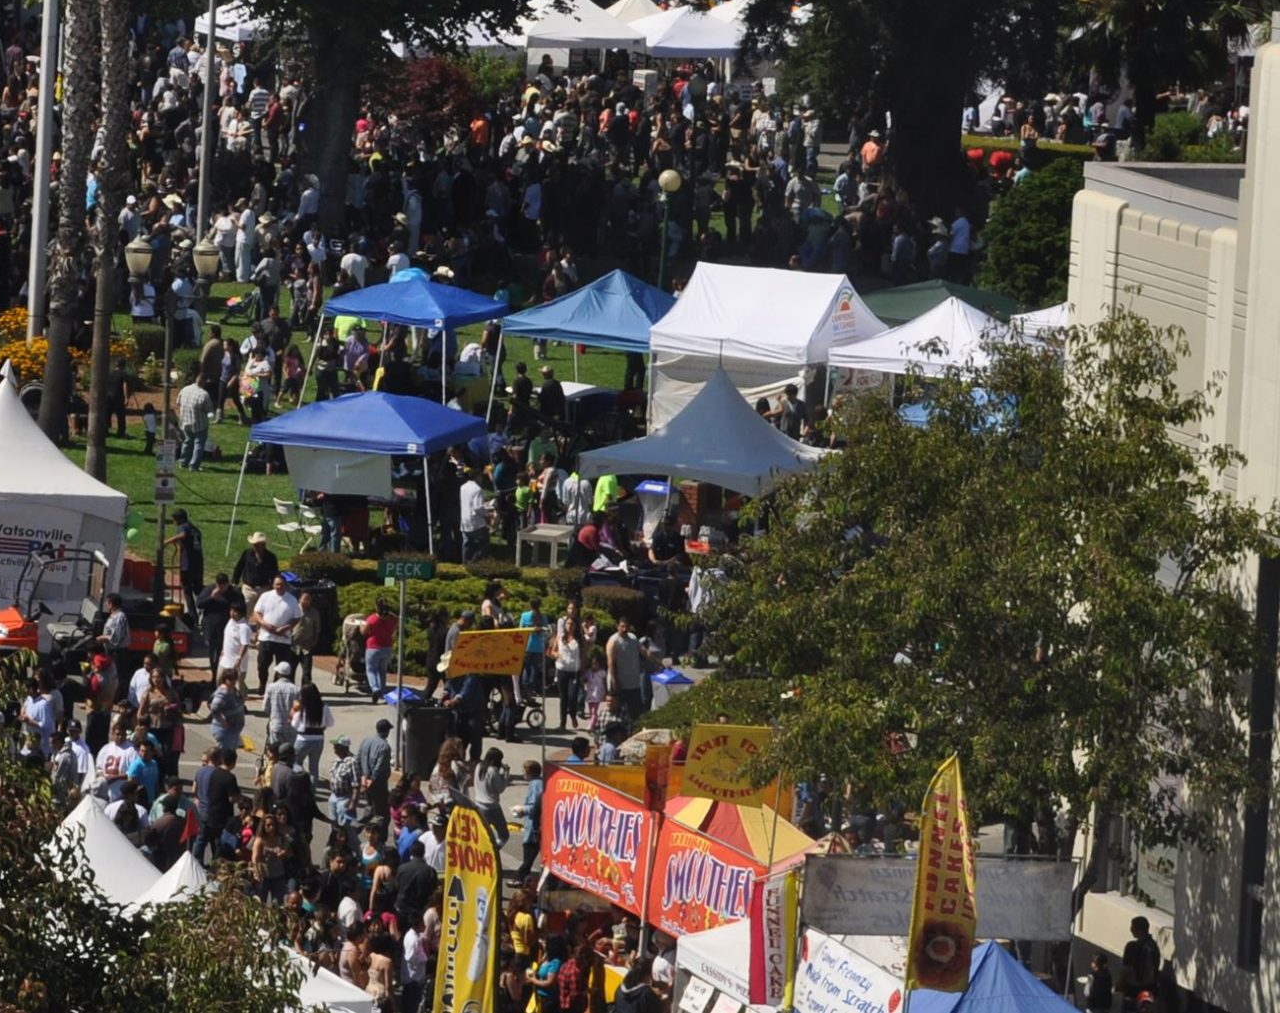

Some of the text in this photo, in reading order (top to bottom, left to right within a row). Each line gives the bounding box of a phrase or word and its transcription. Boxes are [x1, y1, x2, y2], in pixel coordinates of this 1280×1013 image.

[385, 562, 422, 576] PECK
[105, 755, 121, 775] 21
[691, 735, 730, 761] FRUIT
[552, 794, 643, 861] SMOOTHIES
[924, 790, 951, 912] FUNNEL
[663, 848, 754, 919] SMOOTHIES
[766, 889, 782, 949] FUNNEL
[768, 953, 784, 999] CAKE
